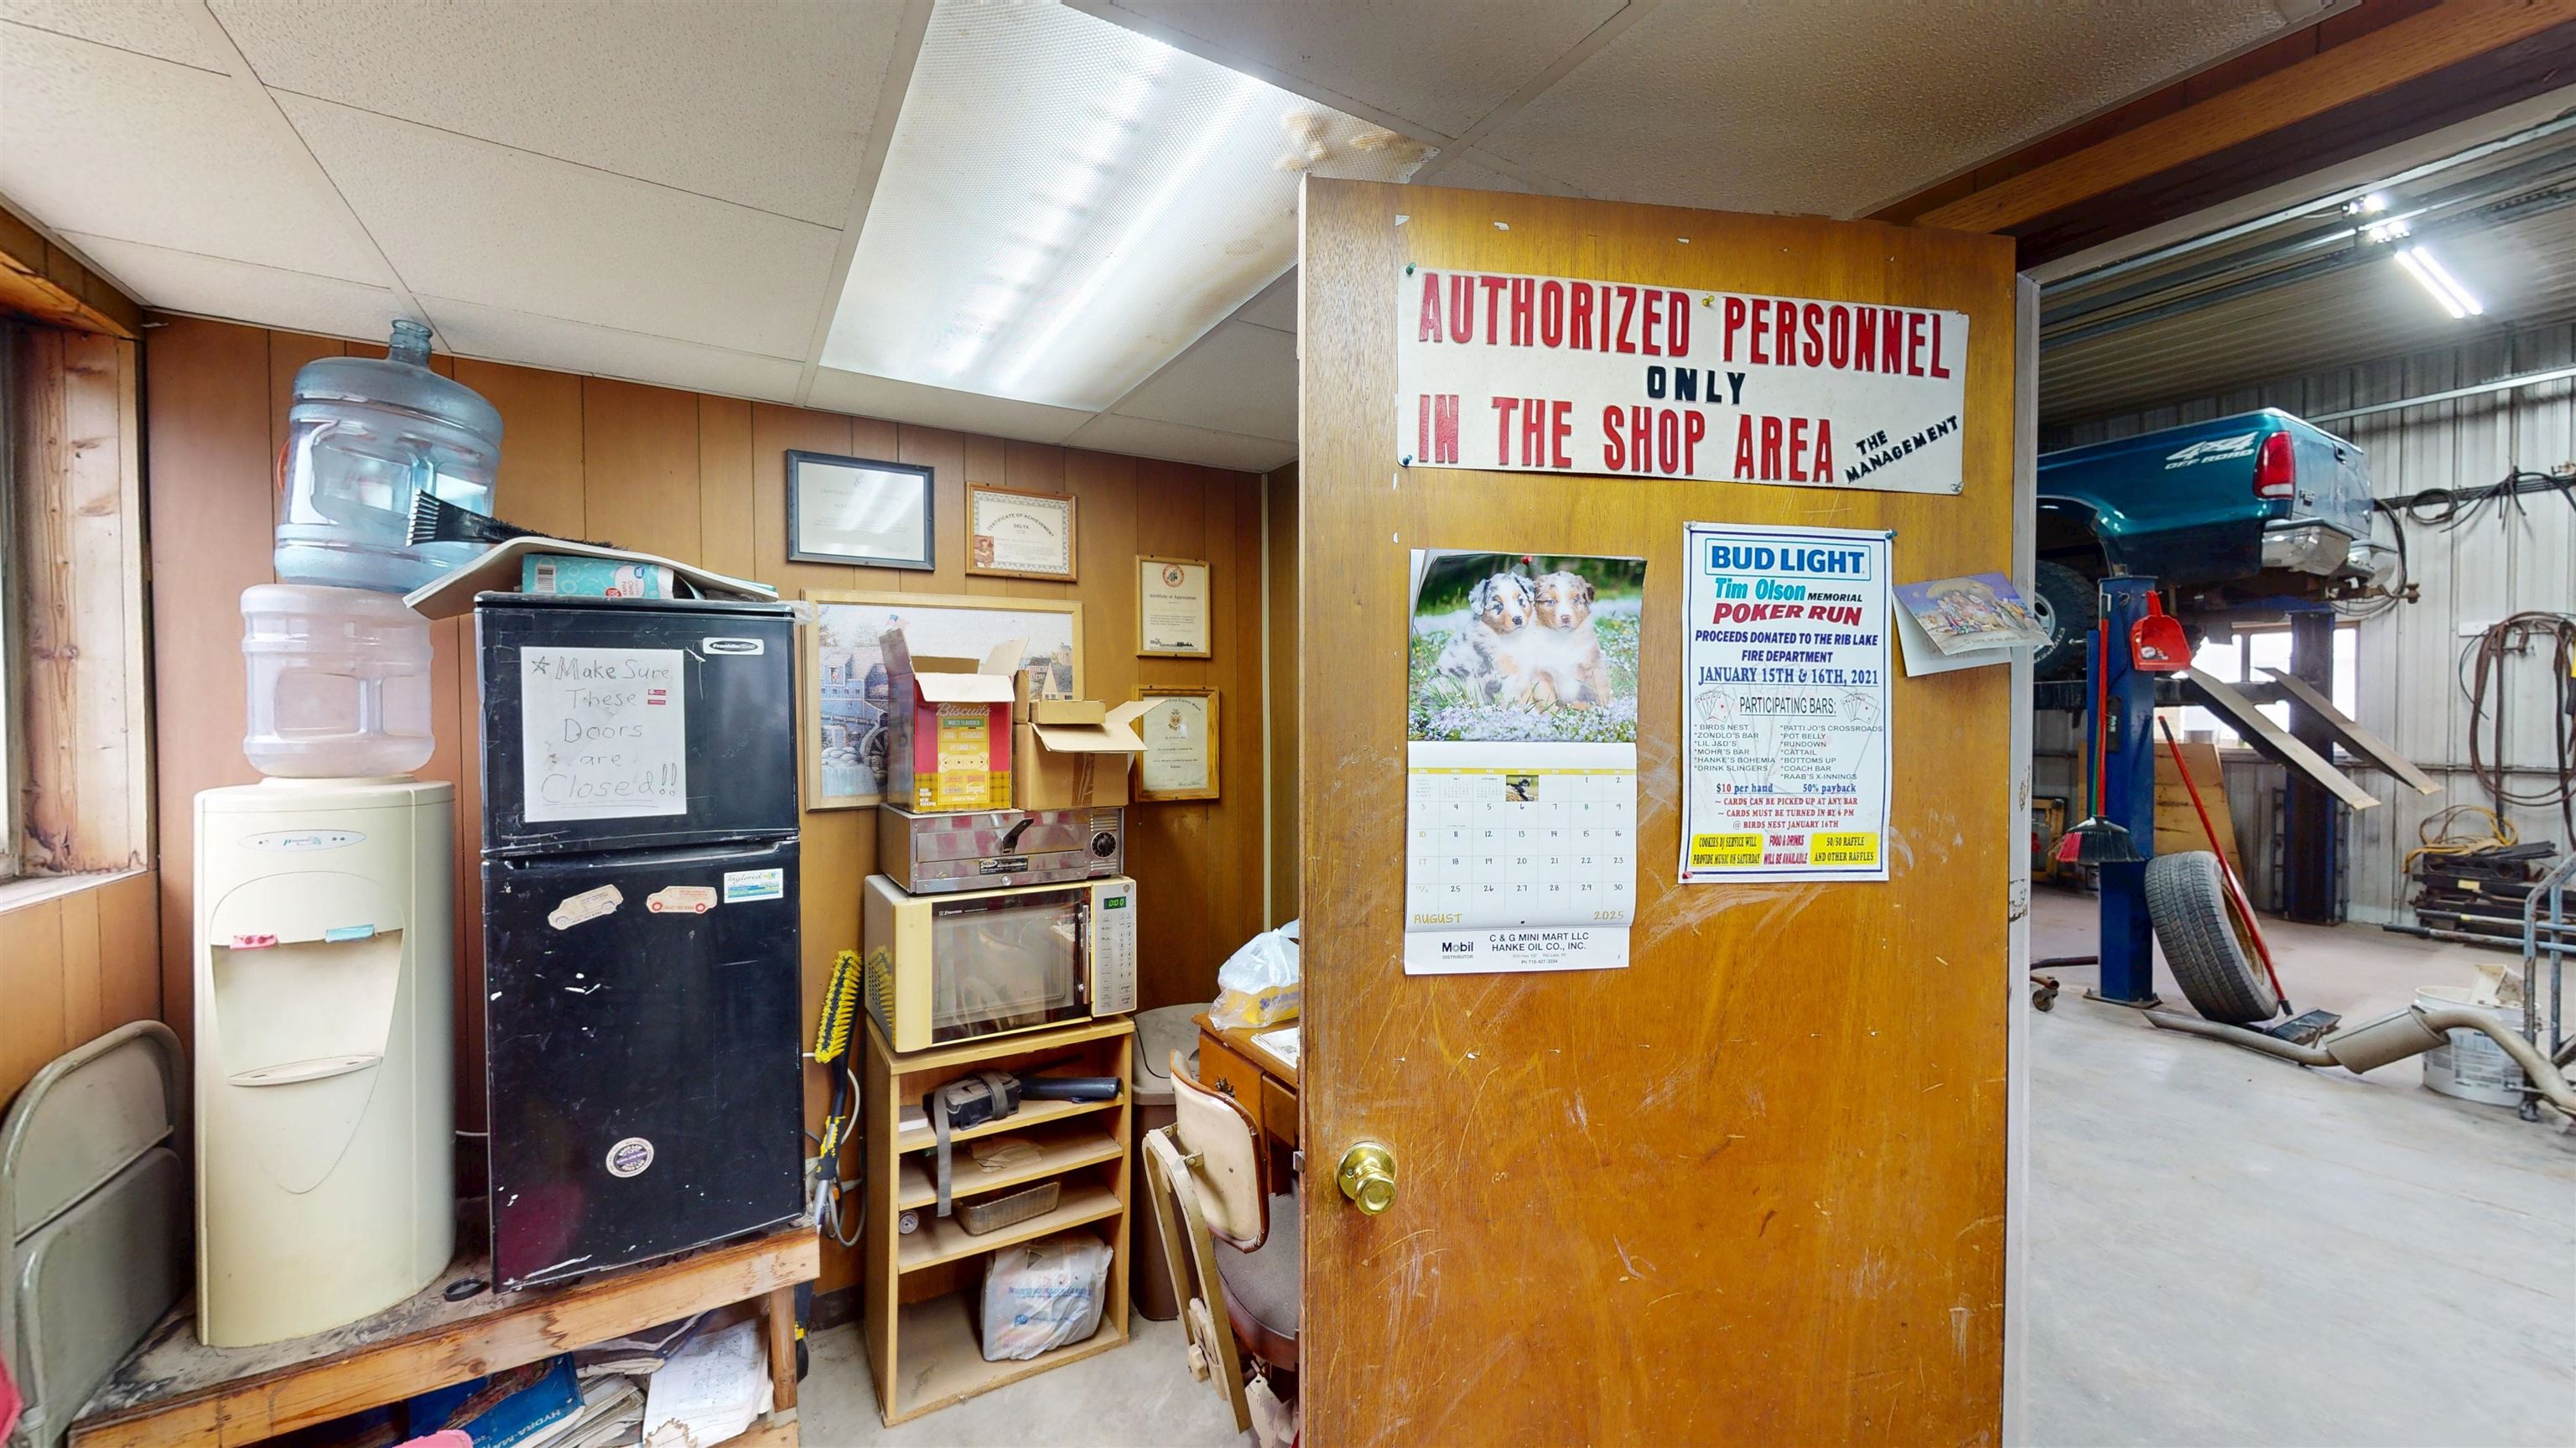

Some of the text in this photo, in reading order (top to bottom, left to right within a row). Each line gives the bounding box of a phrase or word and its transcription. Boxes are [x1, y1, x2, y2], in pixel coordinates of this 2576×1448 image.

[1419, 272, 1951, 379] AUTHORIZED PERSONNEL
[1646, 366, 1747, 406] ONLY
[1418, 394, 1834, 484] IN THE SHOP AREA
[1855, 428, 1888, 457] THE
[1844, 415, 1959, 484] MANAGEMENT
[2164, 449, 2255, 470] OFF ROAD
[1711, 546, 1865, 573] BUD LIGHT
[1715, 578, 1862, 602] Tim Olson MEMORIAL
[1712, 603, 1862, 626] POKER RUN
[1695, 630, 1878, 646] PROCEEDS DONATED TO THE RIB LAKE
[1742, 650, 1833, 663] FIRE DEPARTMENT
[555, 656, 670, 681] Make Sure
[1698, 667, 1878, 687] JANUARY 15TH & 16TH, 2021
[564, 688, 637, 708] These
[1739, 697, 1836, 714] PARTICIPATING BARS:
[936, 703, 991, 717] Biscuits
[564, 718, 644, 744] Doors
[579, 755, 622, 766] are
[1716, 783, 1857, 795] $10 per hand 50% payback
[1723, 797, 1858, 806] CARDS CAN BE PICKED UP AT ANY BAR
[1787, 821, 1820, 830] JANUARY
[1820, 820, 1839, 828] 16TH
[1745, 836, 1757, 847] WILL
[1843, 837, 1865, 847] RAFFLE
[1815, 852, 1874, 862] AND OTHER RAFFLES
[1450, 885, 1461, 893] 25
[1483, 885, 1494, 893] 26
[1581, 884, 1592, 892] 29
[1414, 911, 1624, 924] AUGUST 2025
[1489, 932, 1589, 942] C & G MINI MART LLC
[1441, 941, 1474, 952] Mobil
[1492, 942, 1587, 952] HANKE OIL CO., INC.
[480, 1409, 561, 1448] HYDRA-MA
